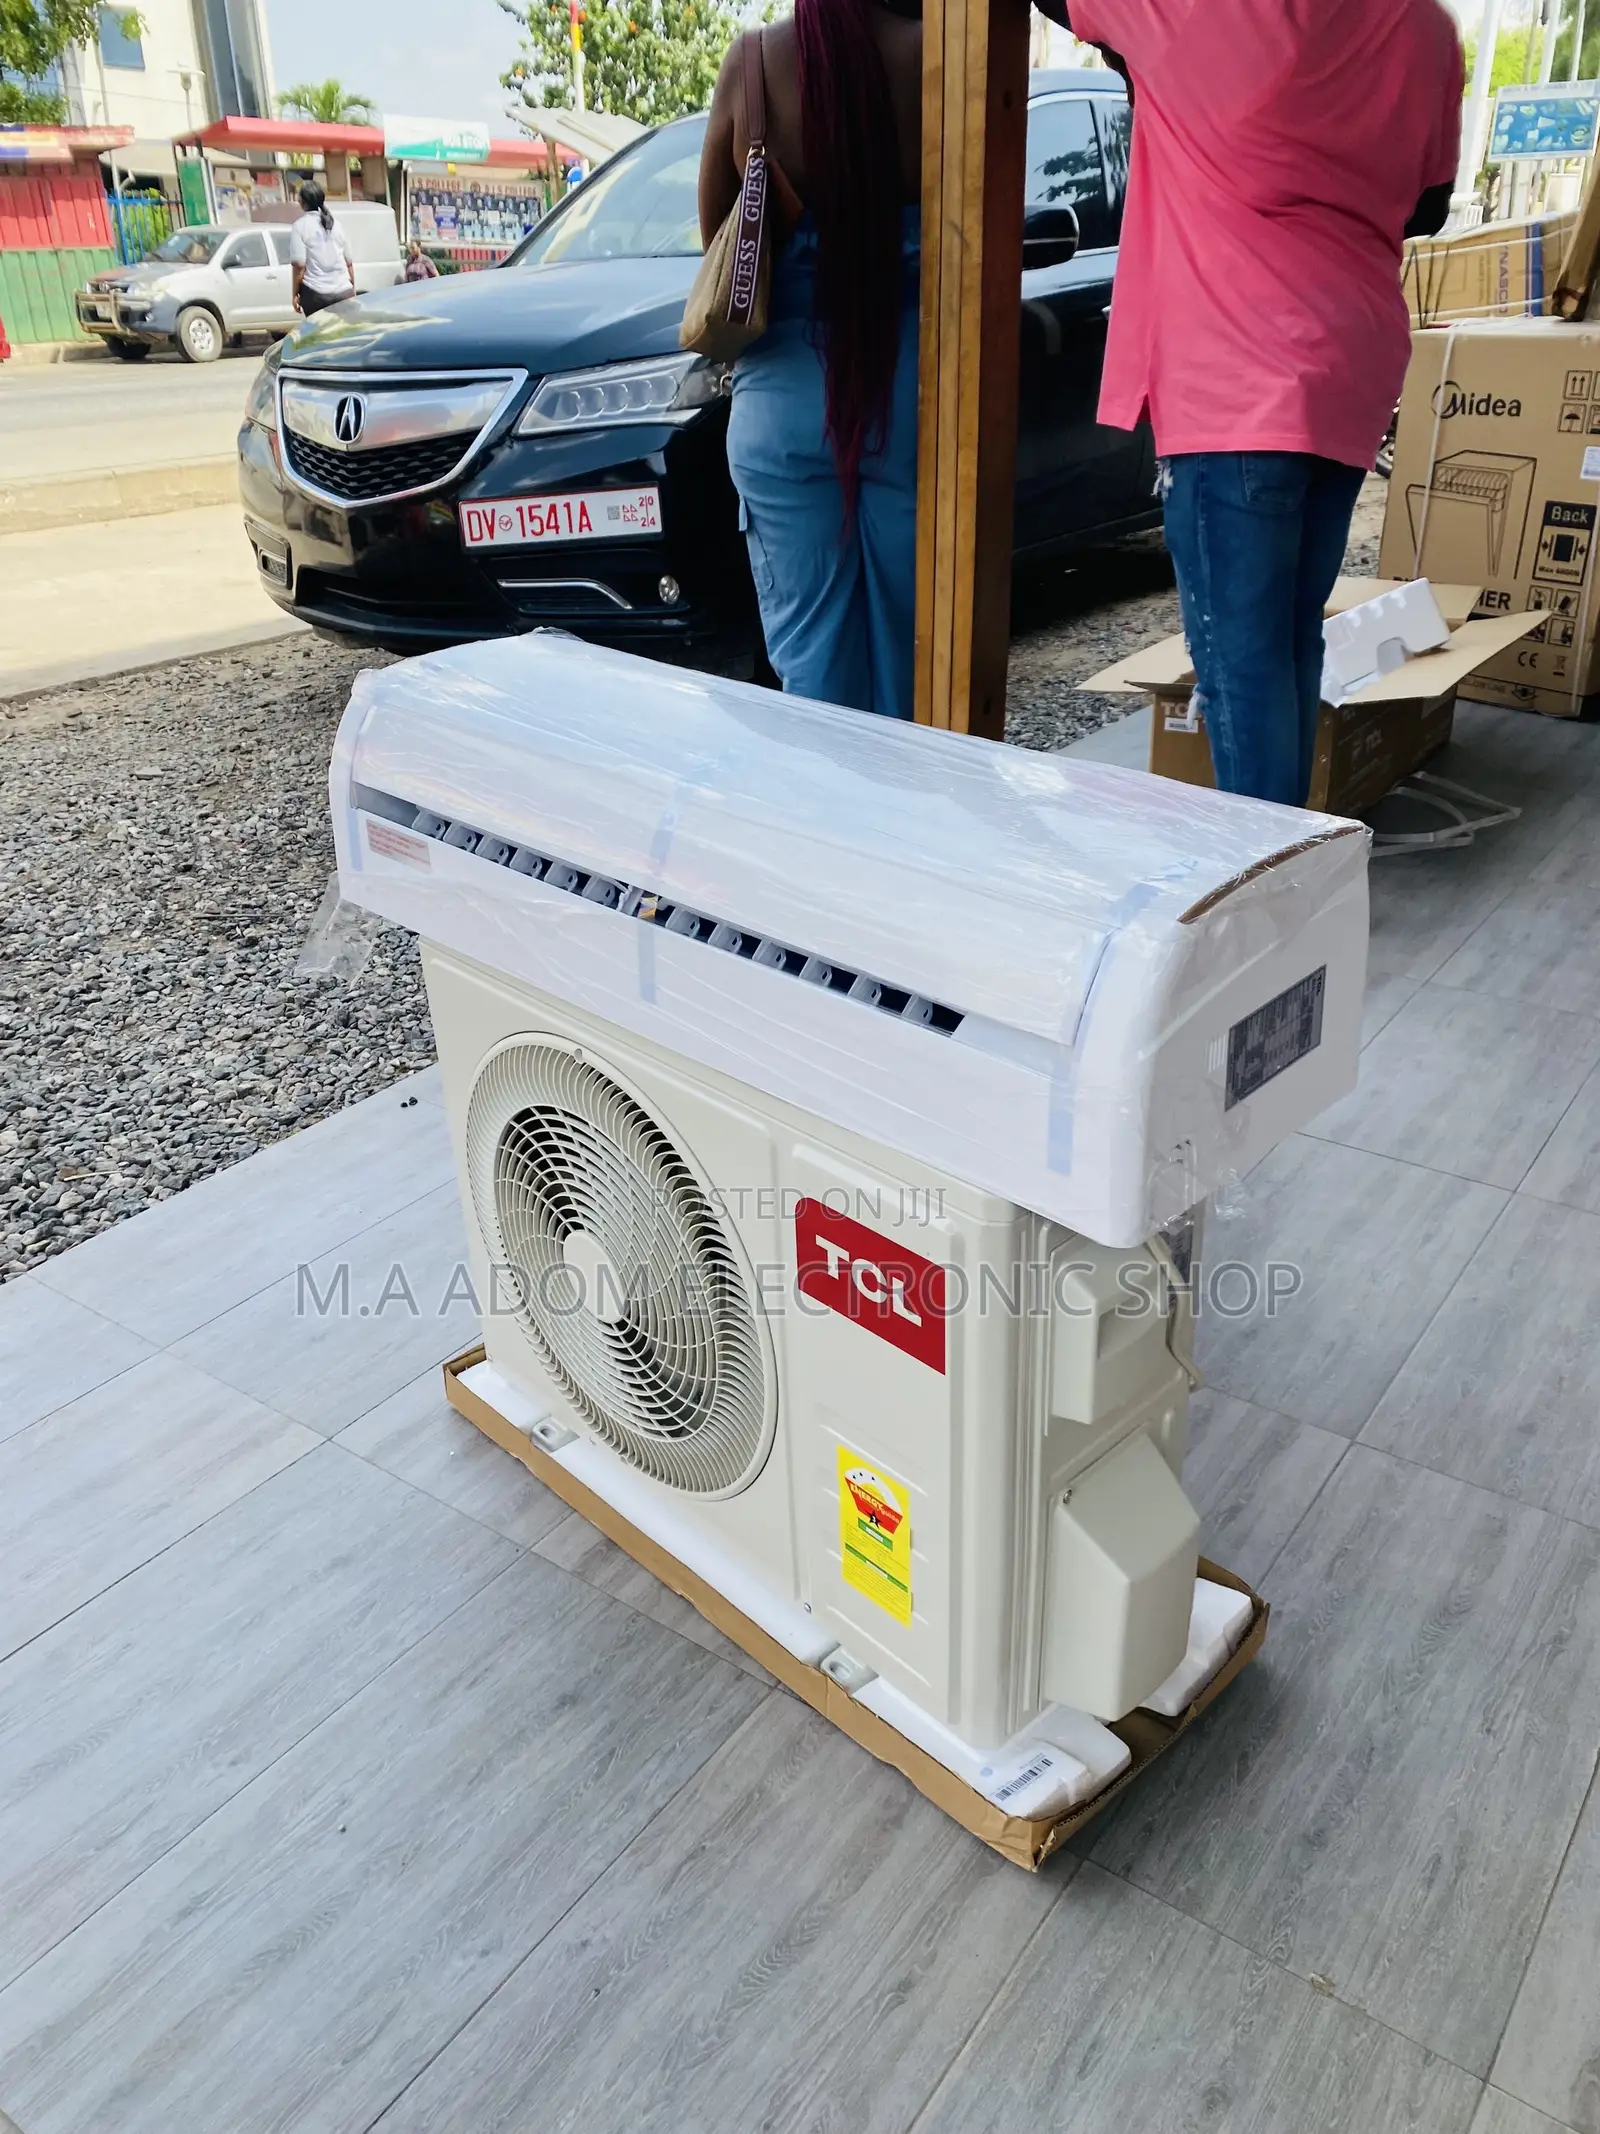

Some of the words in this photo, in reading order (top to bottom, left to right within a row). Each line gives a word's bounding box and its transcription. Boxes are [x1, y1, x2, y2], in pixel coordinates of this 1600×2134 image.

[745, 156, 765, 222] GUESS
[734, 239, 756, 309] GUESS
[1431, 380, 1522, 419] Midea
[466, 508, 496, 542] DV
[516, 501, 593, 538] 1541A
[1551, 505, 1588, 523] Back
[815, 1234, 922, 1328] TCL
